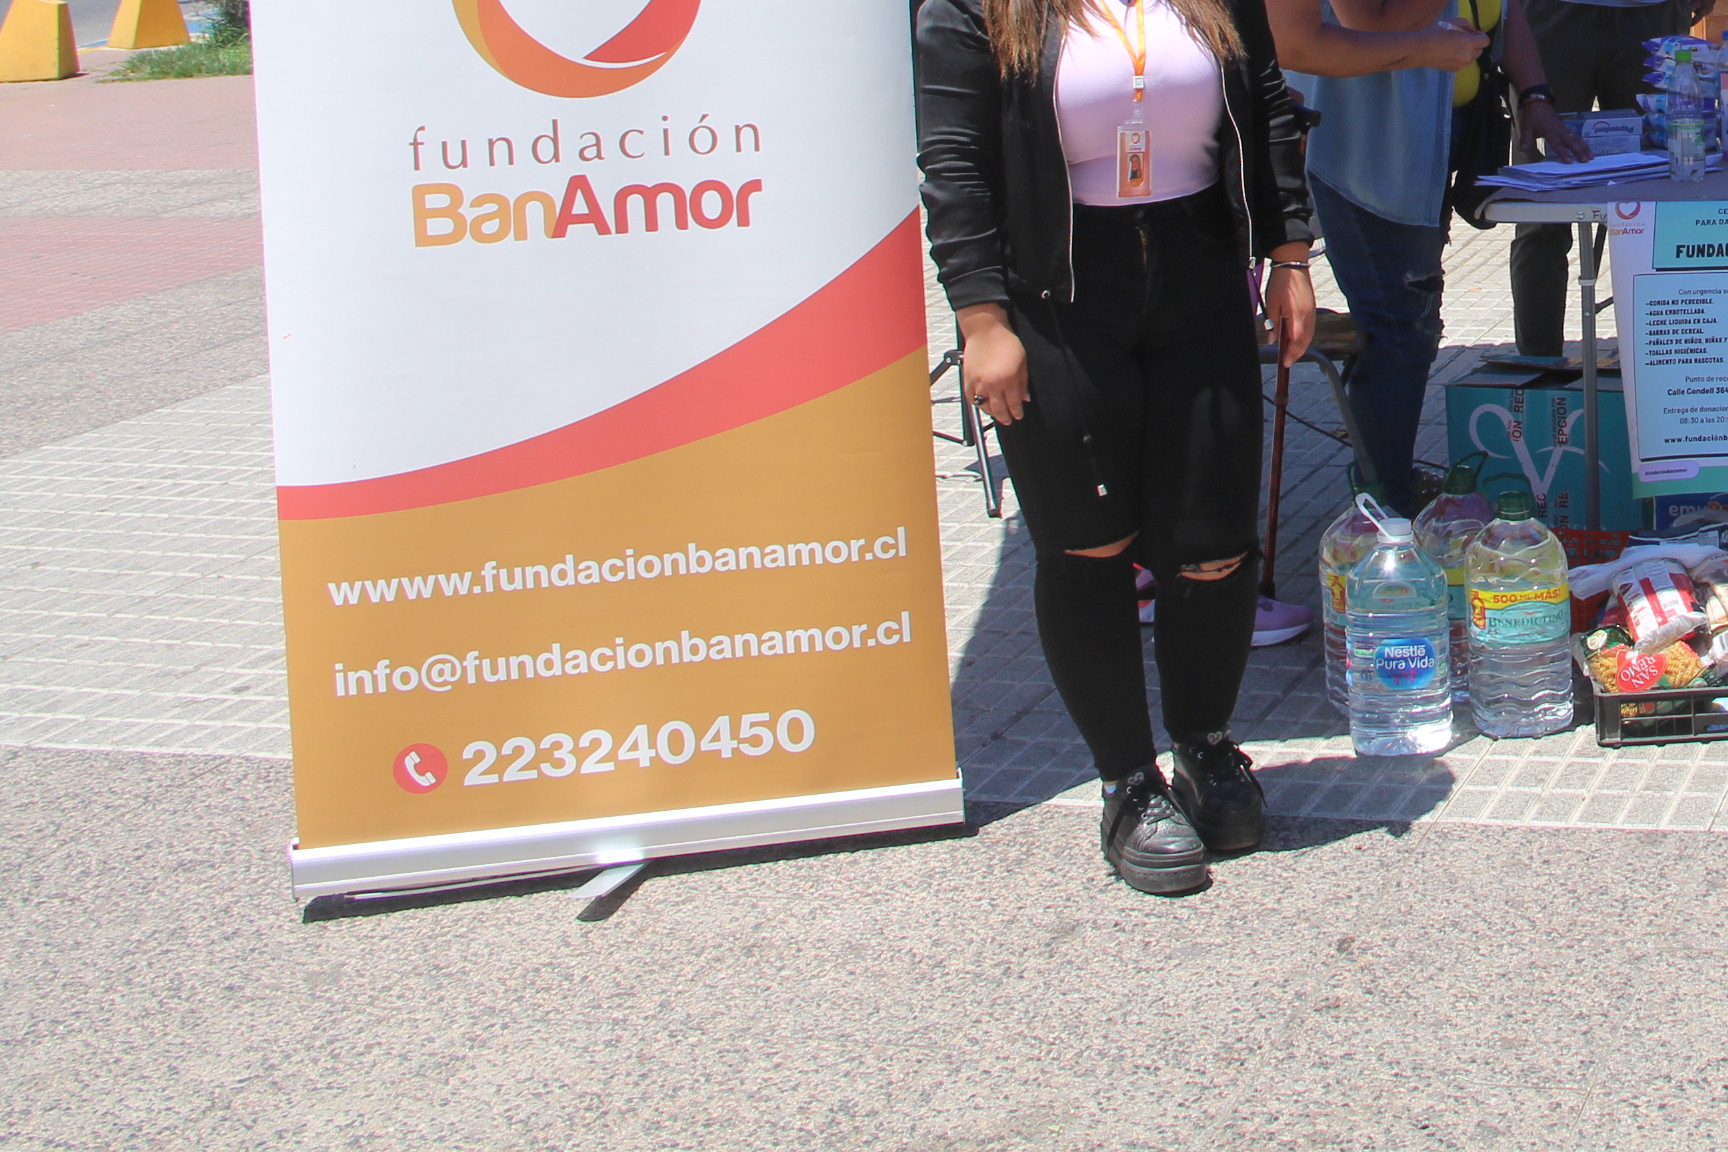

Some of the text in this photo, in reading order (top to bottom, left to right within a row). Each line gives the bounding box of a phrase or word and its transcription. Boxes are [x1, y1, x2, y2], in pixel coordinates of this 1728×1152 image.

[409, 113, 762, 172] fundación
[411, 174, 764, 248] BanAmor
[327, 526, 909, 608] wwww.fundacionbanamor.cl
[1493, 594, 1518, 603] 500
[334, 611, 913, 698] info@fundacionbanamor.cl
[1376, 657, 1435, 670] Pura Vida
[1620, 655, 1656, 682] REMO
[1634, 666, 1658, 688] SAN
[460, 709, 817, 787] 223240450
